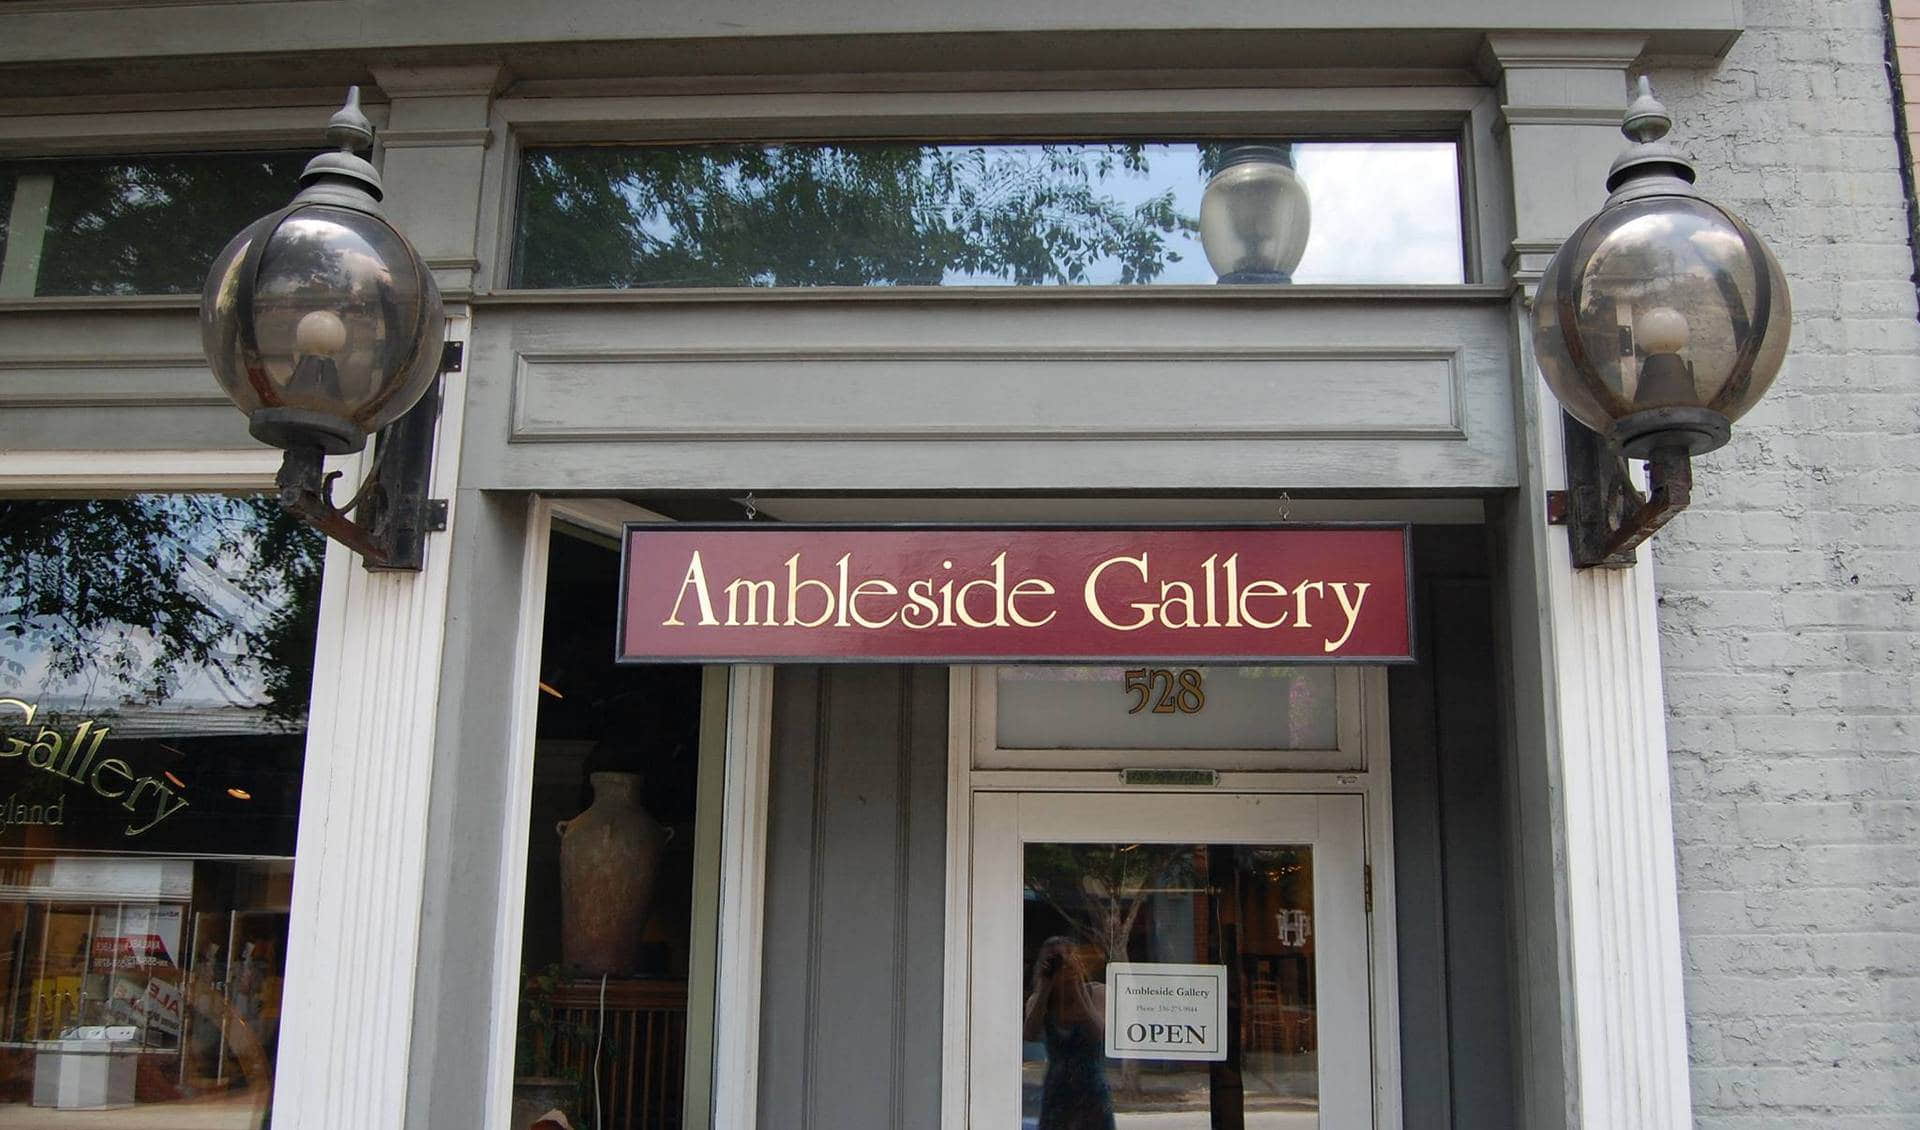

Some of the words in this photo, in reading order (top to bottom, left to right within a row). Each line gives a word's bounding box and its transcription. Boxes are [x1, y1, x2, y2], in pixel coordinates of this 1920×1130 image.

[662, 550, 1057, 629] Ambleside
[1084, 552, 1371, 652] Gallery
[1124, 668, 1206, 715] 528
[0, 697, 190, 836] Gallery
[1125, 987, 1174, 996] Ambleside
[1176, 987, 1210, 999] Gallery
[1126, 1023, 1207, 1044] OPEN
